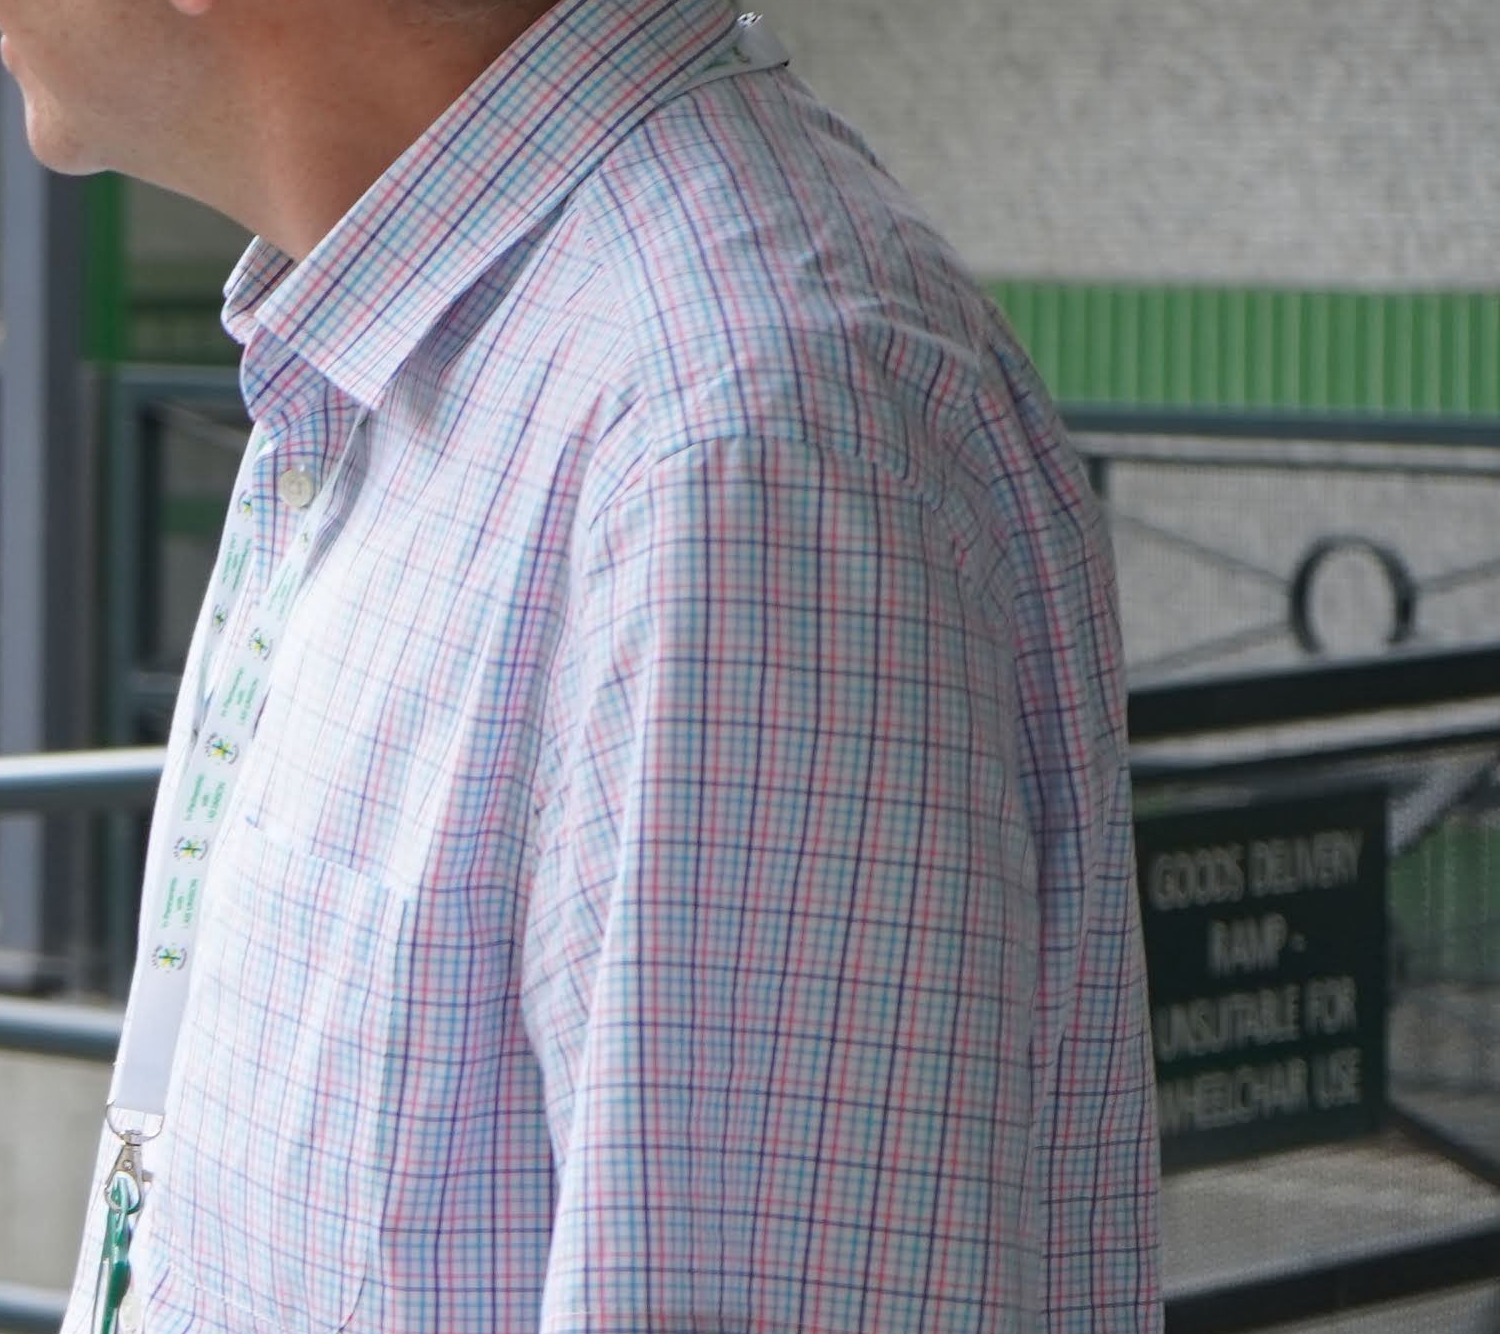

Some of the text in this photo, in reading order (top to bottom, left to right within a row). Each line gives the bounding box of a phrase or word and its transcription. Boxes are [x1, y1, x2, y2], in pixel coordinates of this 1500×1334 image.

[1149, 828, 1363, 911] GOODS DELIVERY
[1208, 913, 1287, 977] RAMP
[1159, 975, 1358, 1063] UNSUITABLE FOR
[1312, 1046, 1362, 1110] USE
